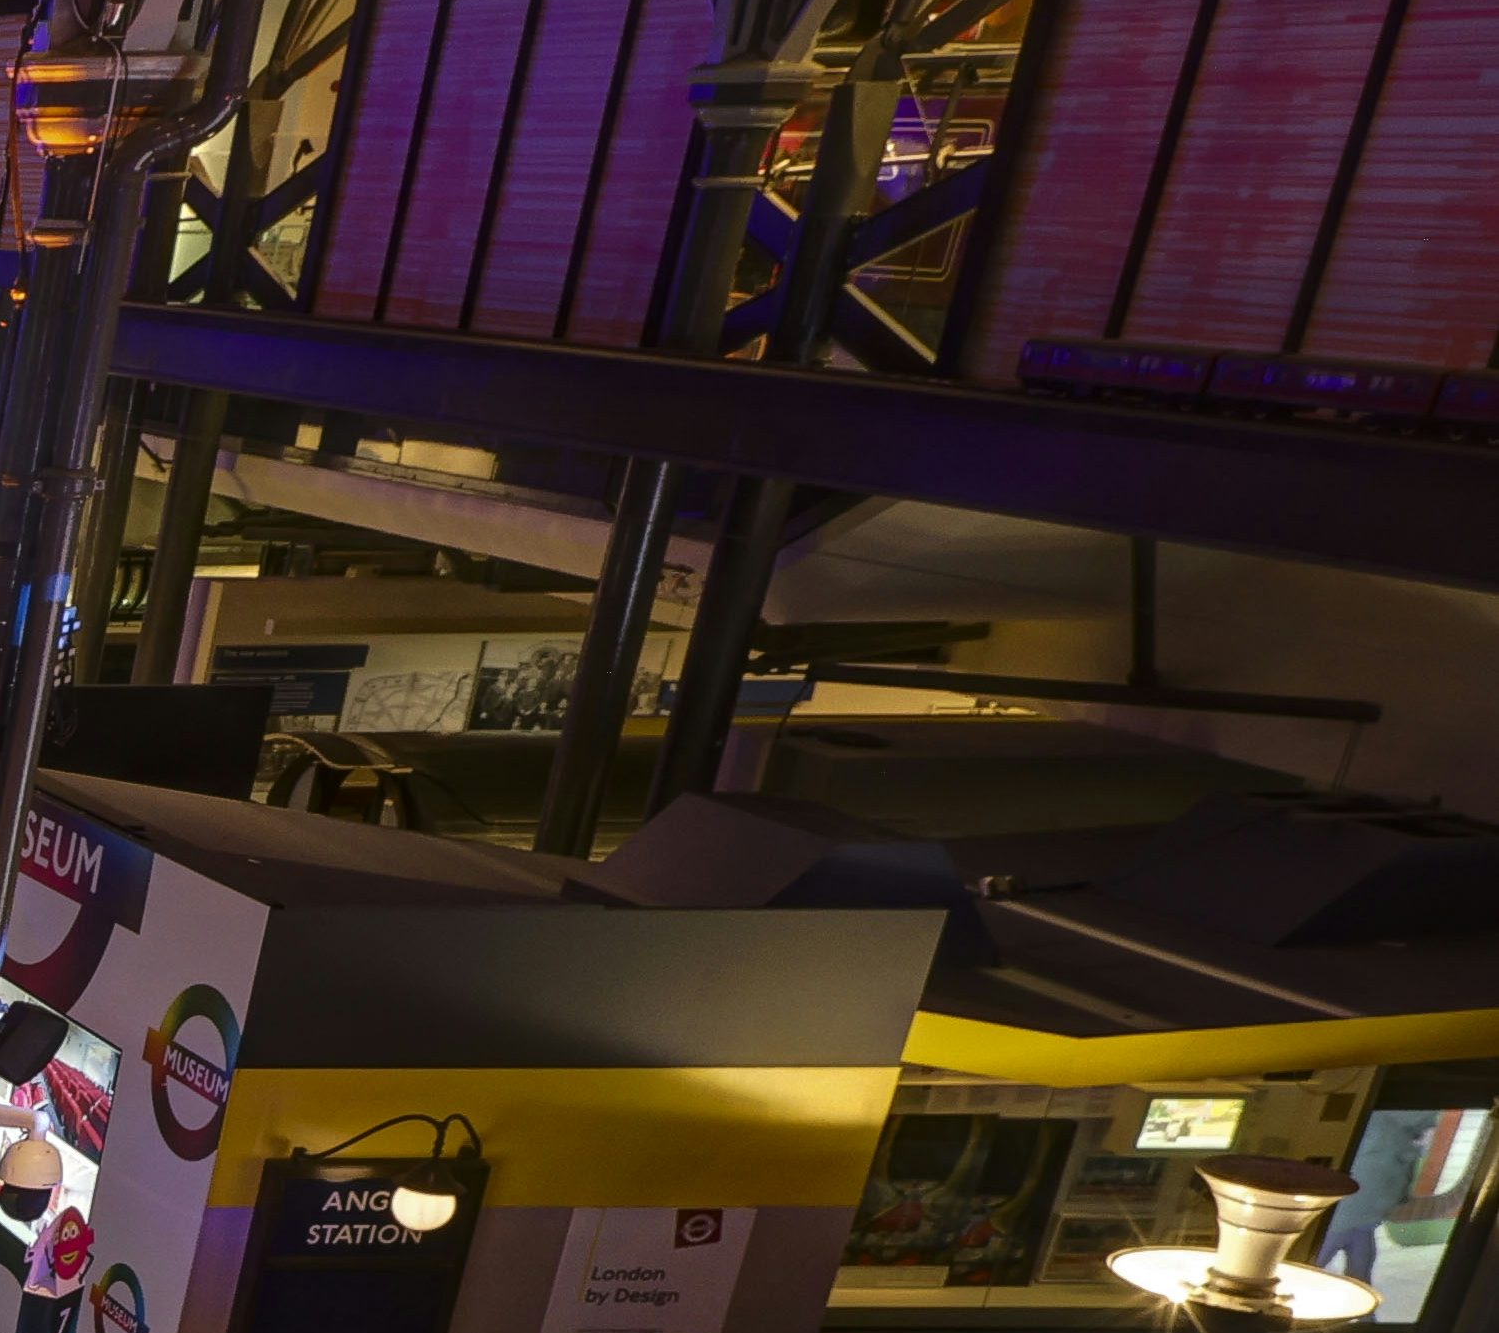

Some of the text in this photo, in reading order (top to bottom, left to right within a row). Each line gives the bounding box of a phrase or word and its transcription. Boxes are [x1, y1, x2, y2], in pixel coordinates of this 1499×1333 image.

[21, 810, 104, 895] SEUM
[162, 1044, 230, 1104] MUSEUM
[321, 1190, 392, 1212] ANG
[306, 1224, 424, 1245] STATION
[591, 1266, 666, 1282] London
[584, 1288, 680, 1306] by Design
